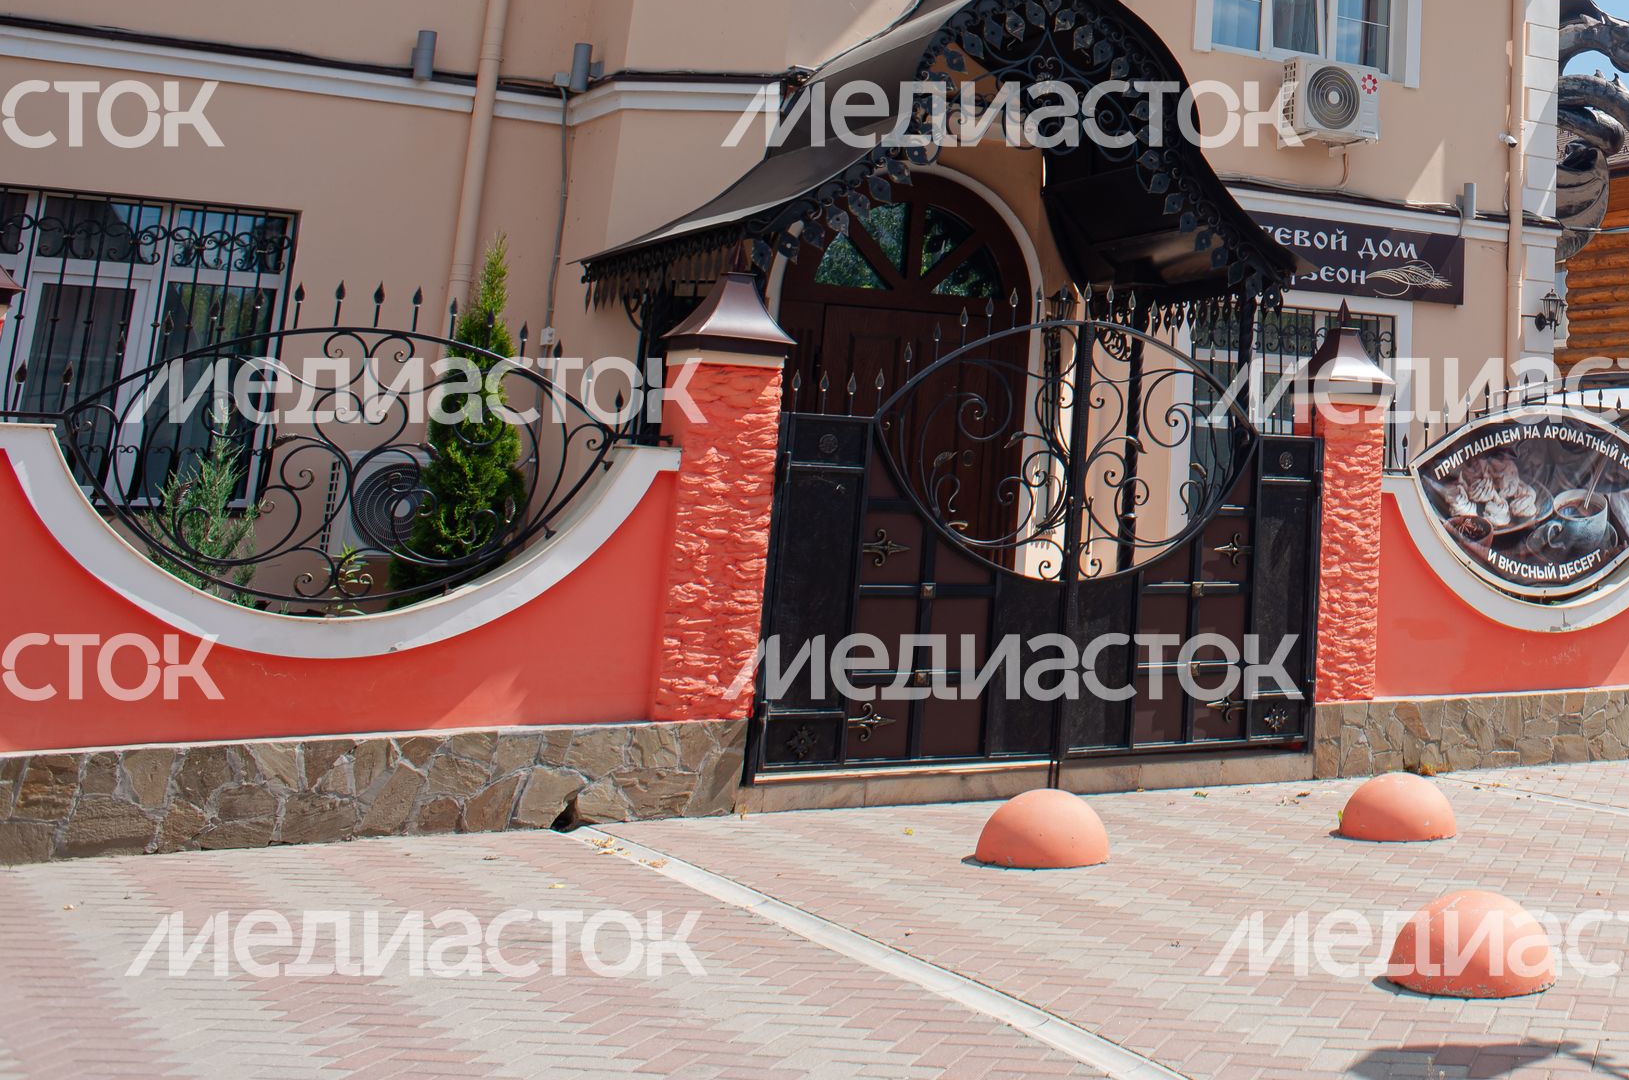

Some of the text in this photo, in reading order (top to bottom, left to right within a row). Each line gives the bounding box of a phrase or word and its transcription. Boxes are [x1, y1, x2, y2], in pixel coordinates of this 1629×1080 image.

[1434, 428, 1521, 481] ПРИГЛАШАЕМ
[1523, 425, 1541, 439] НА
[1543, 424, 1620, 461] АРОМАТНЫЙ
[1487, 548, 1602, 581] И ВКУСНЫЙ ДЕСЕРТ
